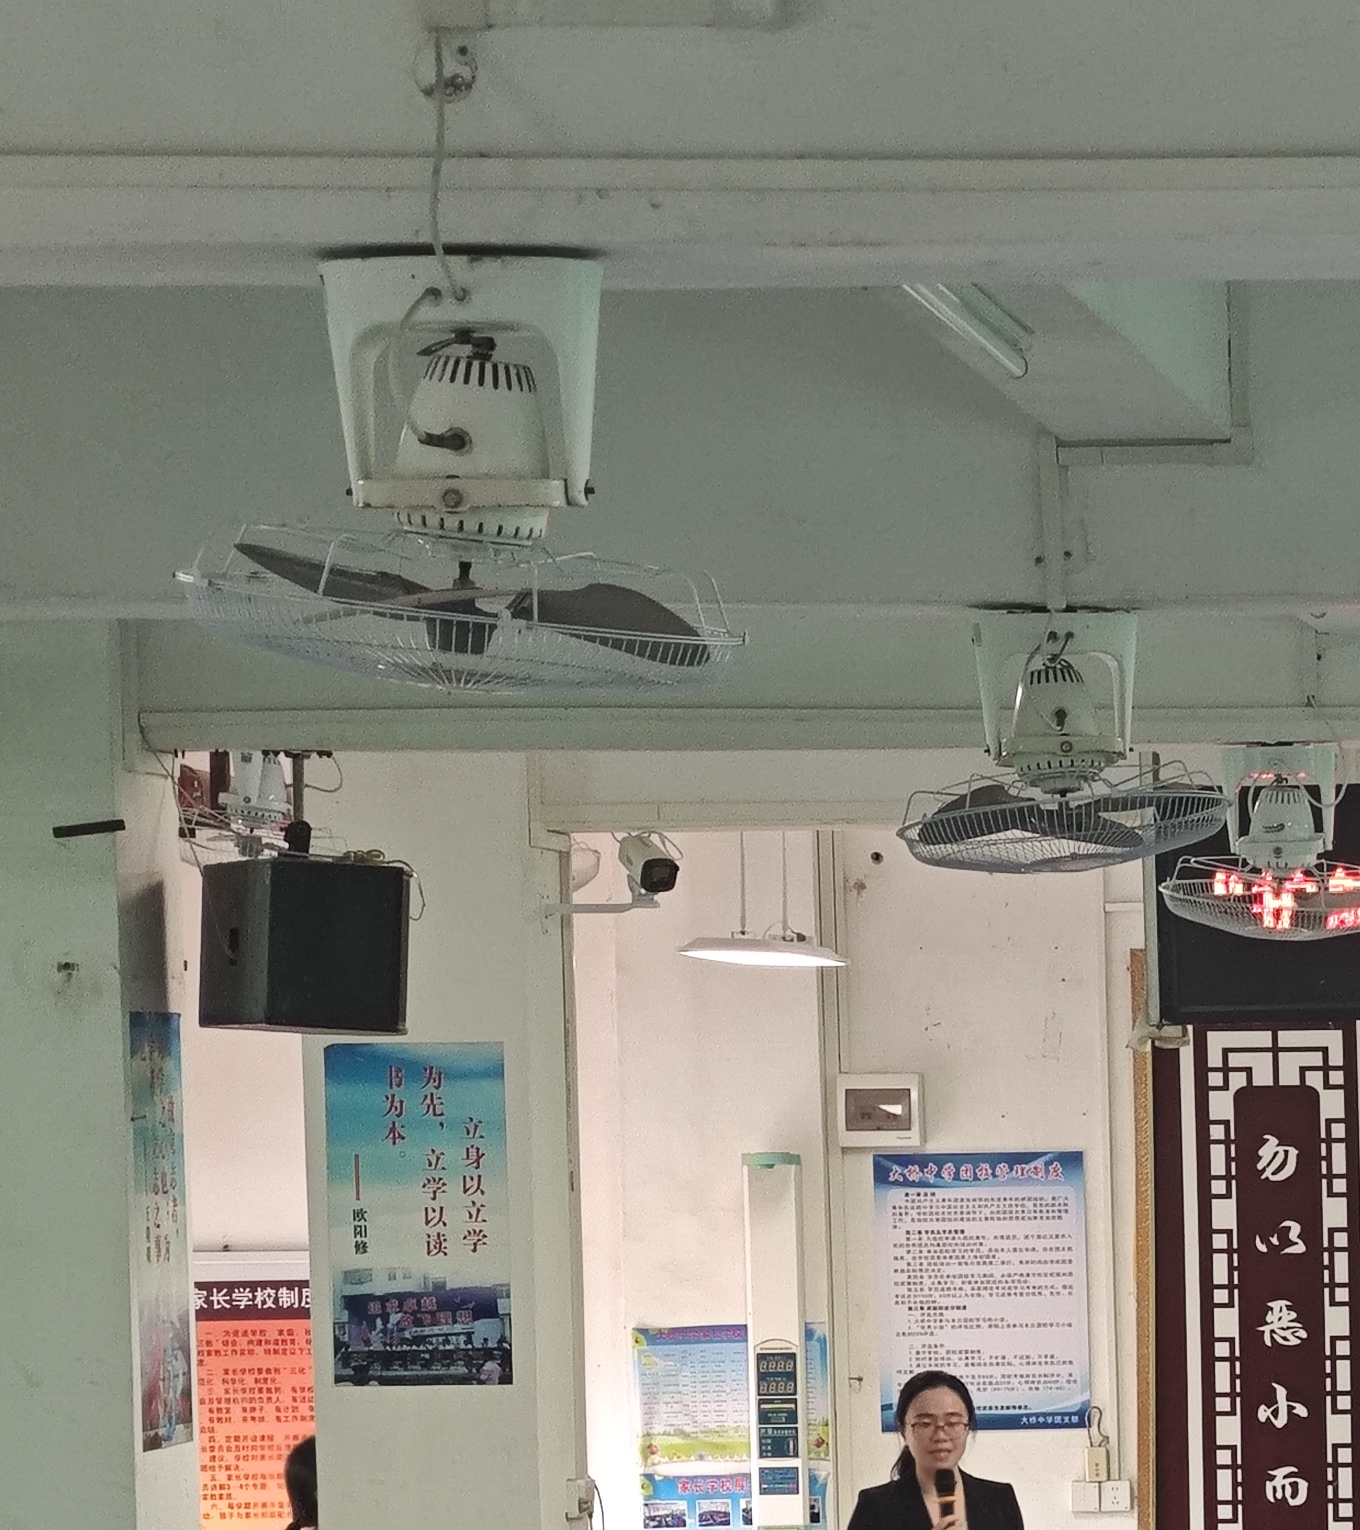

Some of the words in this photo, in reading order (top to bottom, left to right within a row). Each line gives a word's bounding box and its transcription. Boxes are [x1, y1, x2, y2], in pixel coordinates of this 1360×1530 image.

[462, 1116, 488, 1254] 立身以立学
[678, 1477, 751, 1495] 家长学校展
